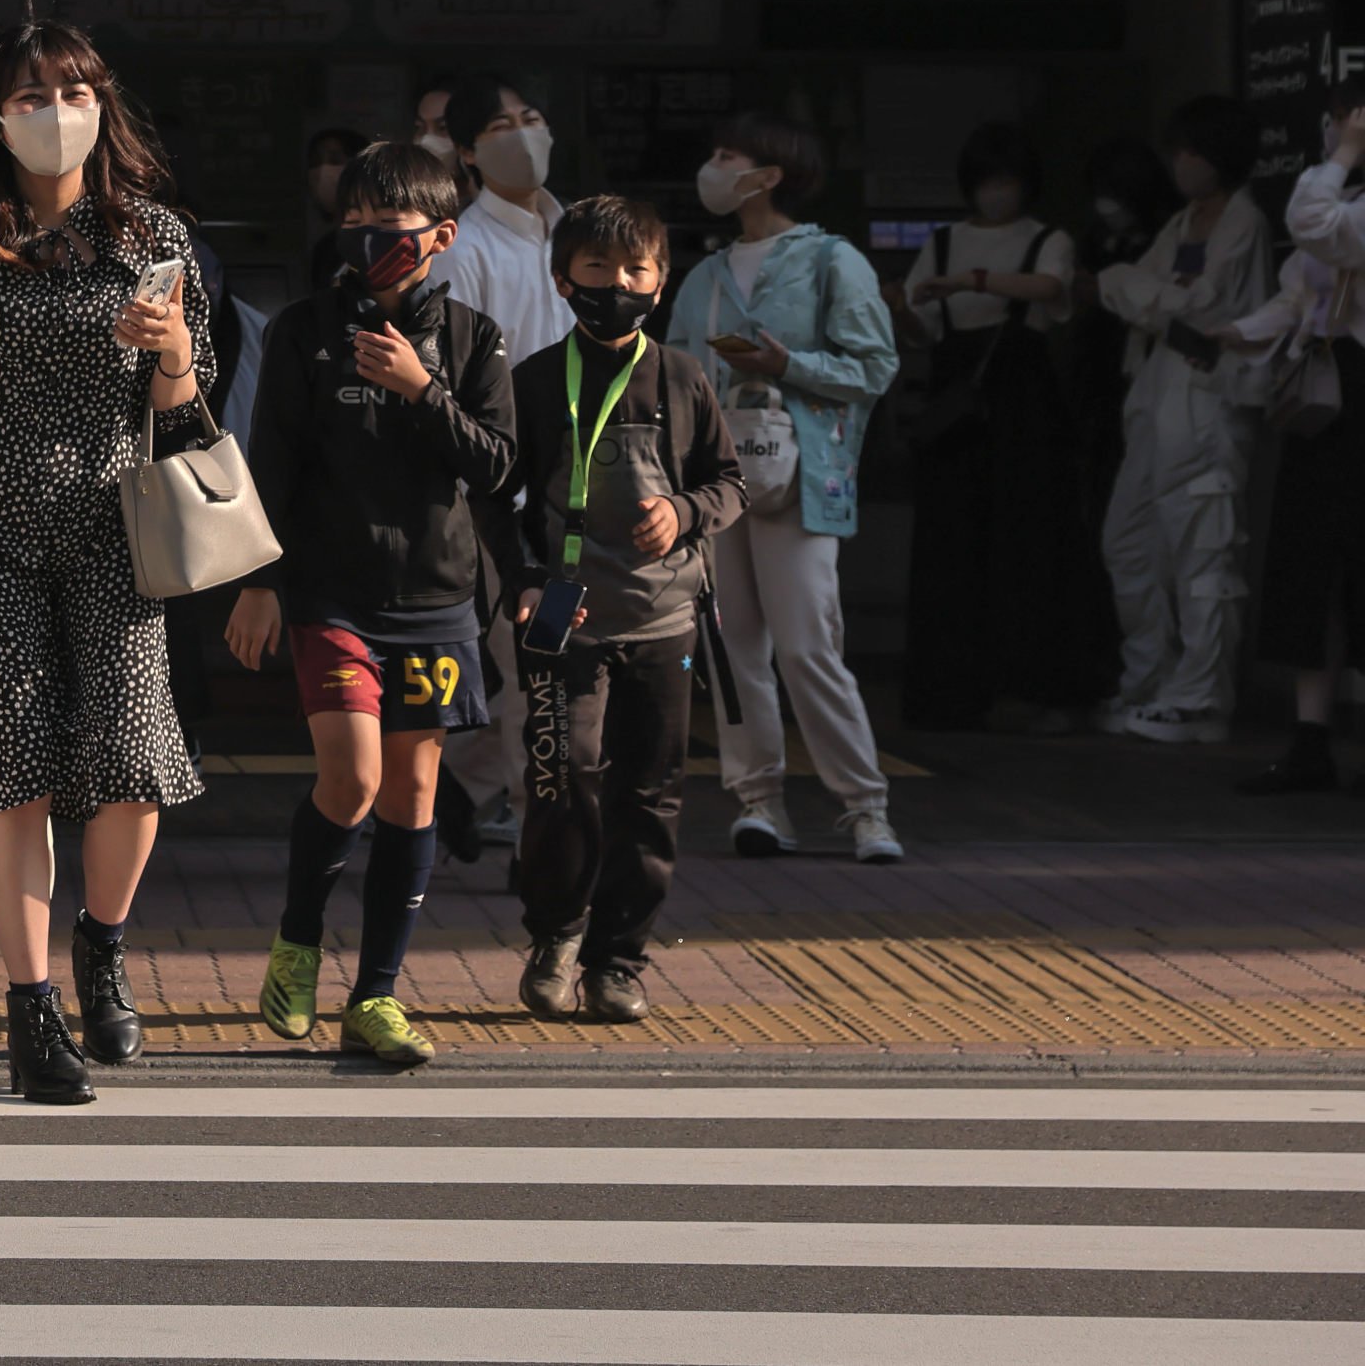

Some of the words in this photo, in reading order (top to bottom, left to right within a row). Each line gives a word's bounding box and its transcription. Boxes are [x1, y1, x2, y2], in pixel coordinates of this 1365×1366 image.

[403, 656, 461, 706] 59
[528, 670, 558, 803] SVOLME
[558, 733, 570, 761] con
